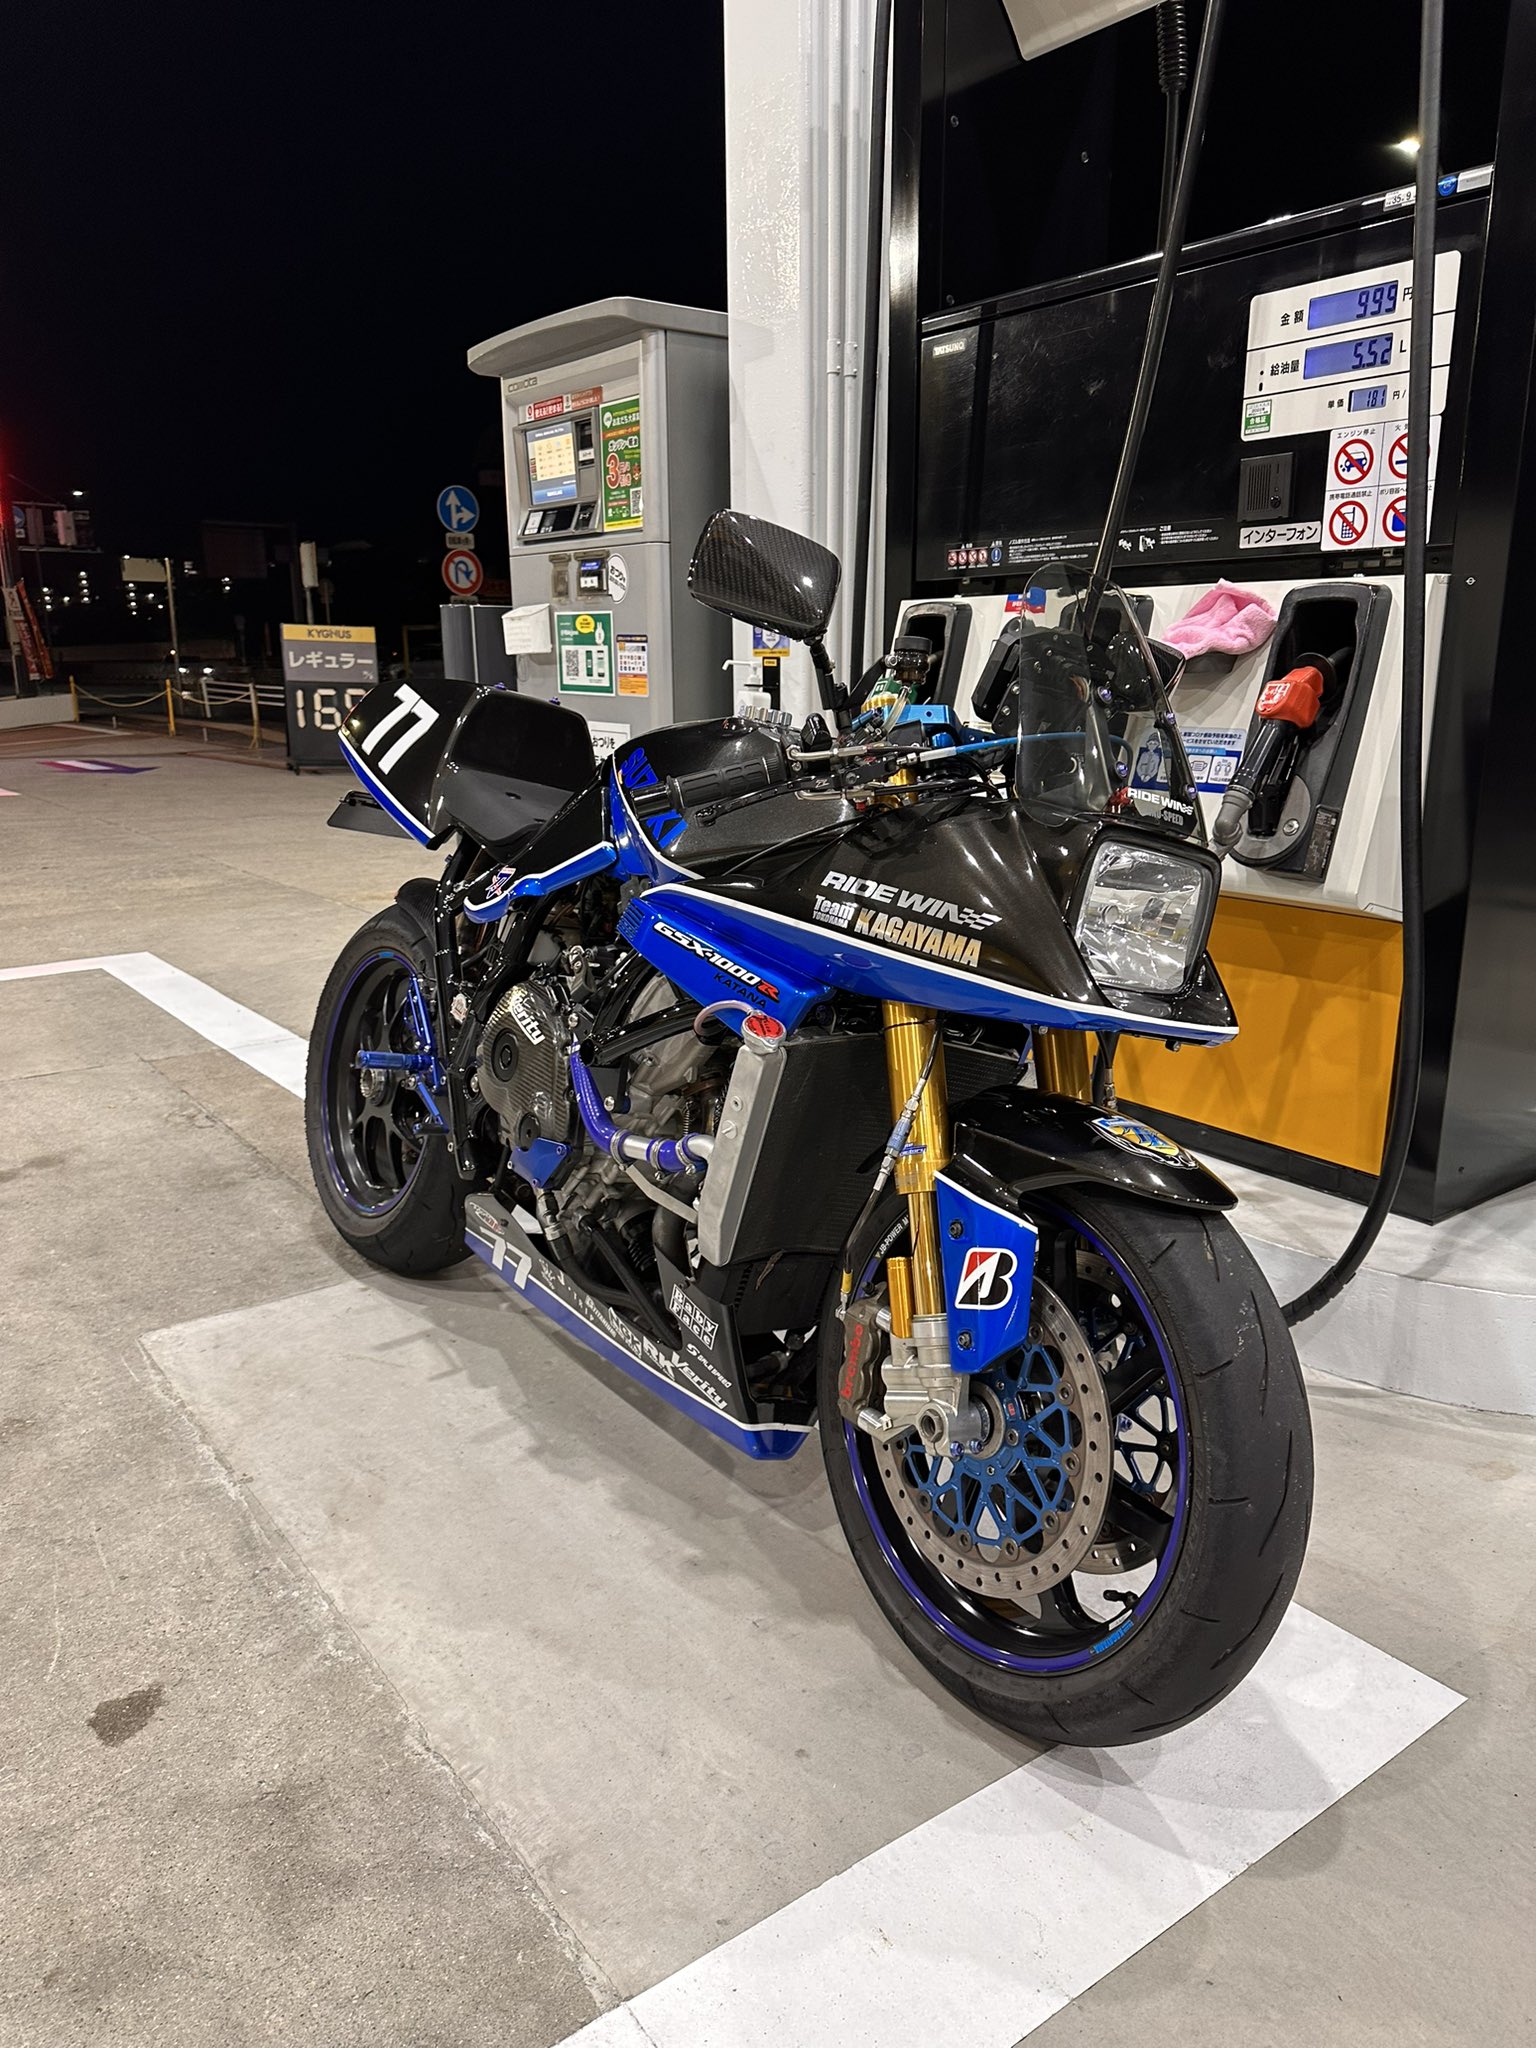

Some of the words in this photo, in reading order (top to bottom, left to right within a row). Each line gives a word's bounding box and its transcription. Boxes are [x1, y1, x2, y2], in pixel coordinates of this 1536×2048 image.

[1356, 284, 1397, 319] 999
[1270, 360, 1300, 376] 給油量
[1351, 337, 1393, 370] 5.52
[1399, 340, 1407, 353] L
[1366, 389, 1386, 407] 181
[1337, 428, 1376, 439] エンジン停止
[1243, 525, 1318, 545] インターフォン
[307, 629, 352, 639] KYGNUS
[289, 651, 374, 670] レギュラー
[821, 870, 899, 904] RIDE
[814, 894, 855, 921] Team
[854, 907, 982, 967] KAGAYAMA
[713, 973, 766, 1009] KATANA
[479, 1226, 532, 1290] 77
[671, 1351, 728, 1410] Verity
